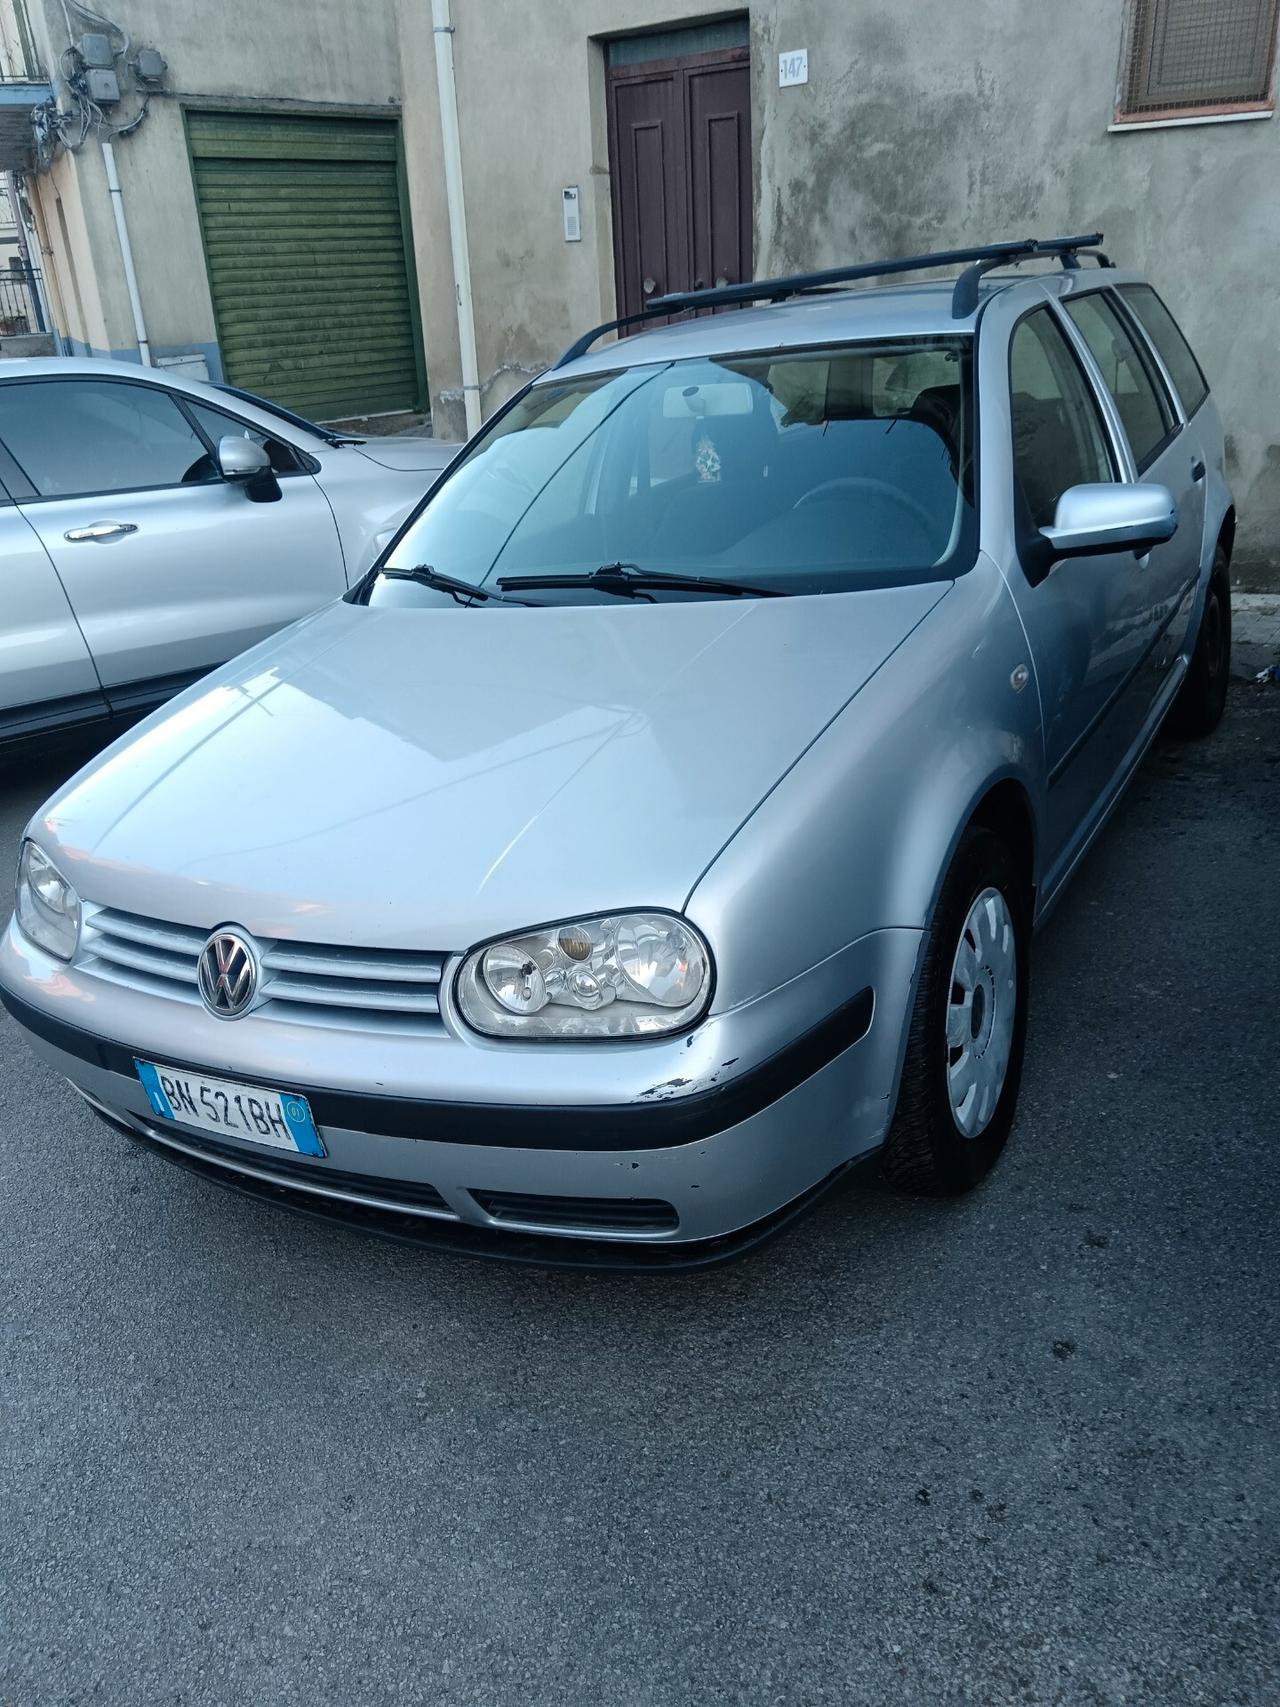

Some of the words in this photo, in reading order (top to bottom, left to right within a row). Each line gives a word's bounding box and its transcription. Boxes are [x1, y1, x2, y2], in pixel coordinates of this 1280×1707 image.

[782, 56, 803, 79] 147
[199, 935, 256, 1014] VW
[160, 1075, 200, 1118] BN
[199, 1086, 292, 1141] 521BH
